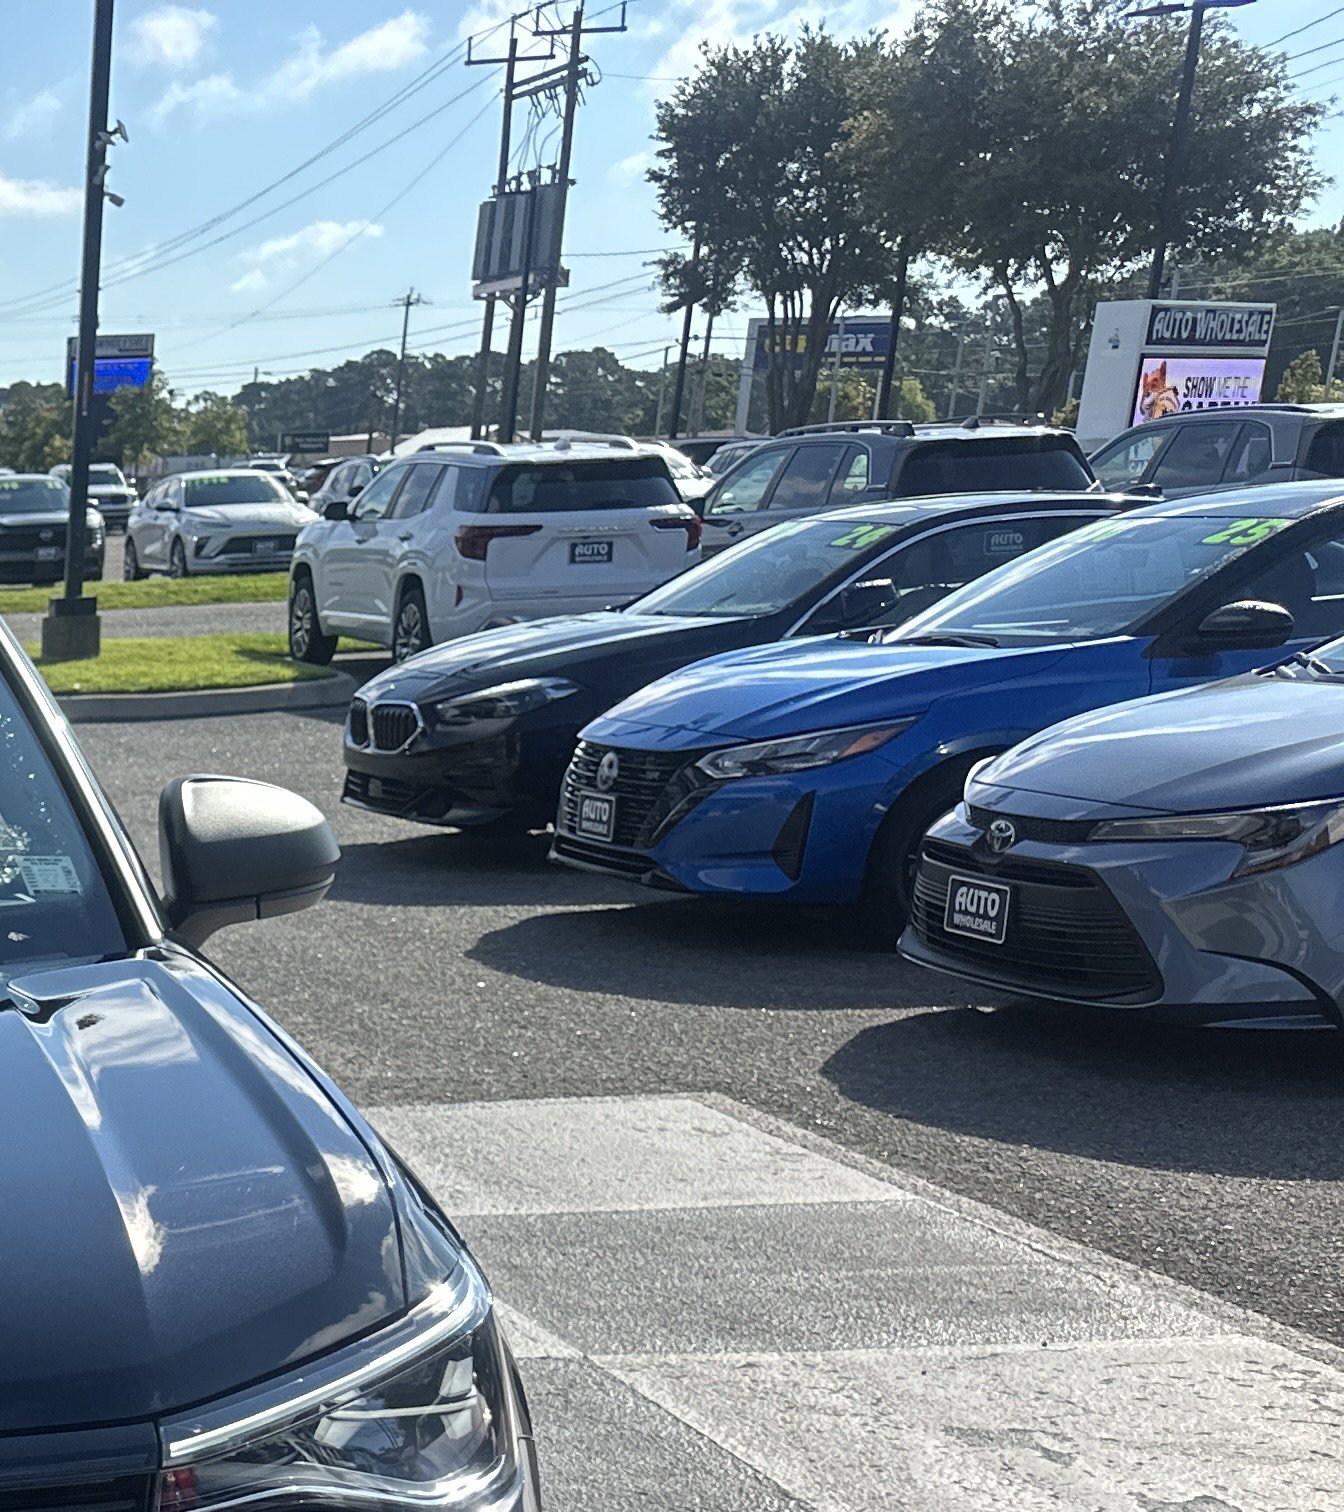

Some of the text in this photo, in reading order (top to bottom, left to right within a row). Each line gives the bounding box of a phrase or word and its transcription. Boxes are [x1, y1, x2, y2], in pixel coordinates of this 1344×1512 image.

[1152, 311, 1271, 342] AUTO WHOLESALE
[1183, 376, 1216, 398] SHOW
[575, 543, 609, 556] AUTO
[583, 799, 609, 822] AUTO
[955, 886, 1000, 918] AUTO
